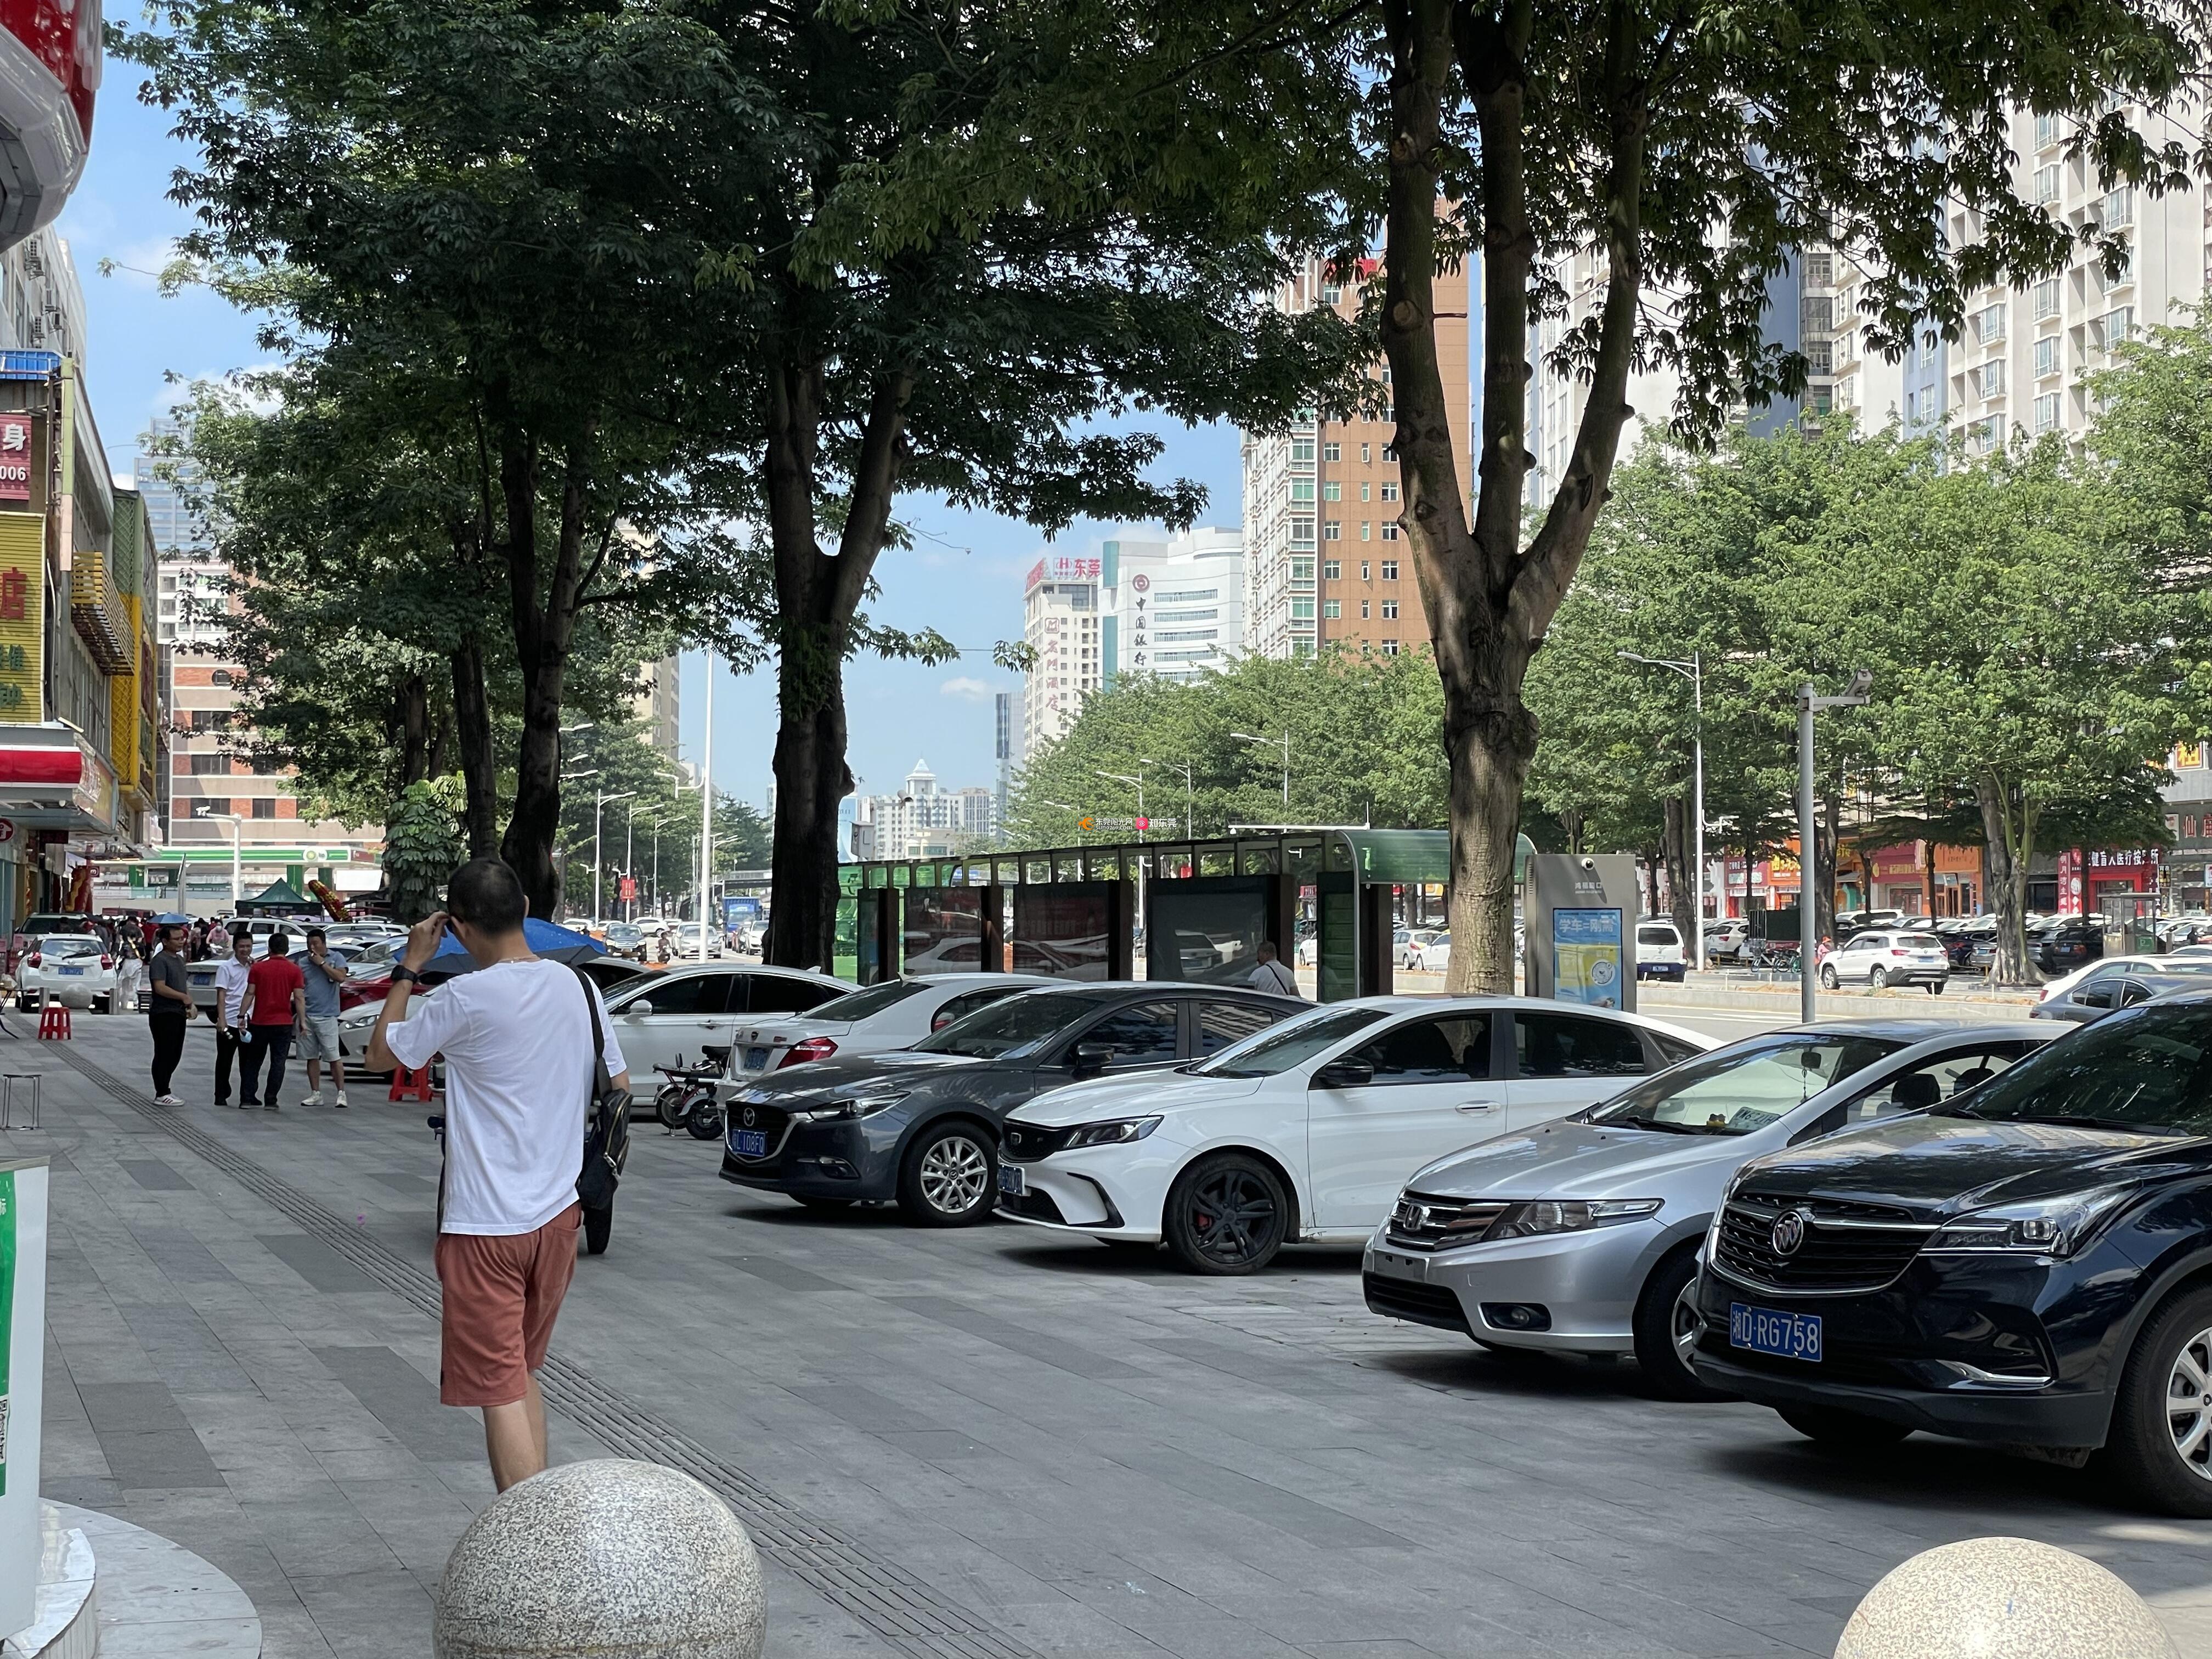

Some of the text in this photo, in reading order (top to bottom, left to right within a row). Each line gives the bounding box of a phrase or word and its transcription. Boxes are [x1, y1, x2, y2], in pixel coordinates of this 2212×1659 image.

[3, 424, 26, 451] 身
[1074, 558, 1101, 578] 东莞
[0, 567, 27, 620] 店
[1133, 597, 1148, 666] 中国银行
[2088, 849, 2159, 866] 健盲人医疗按所
